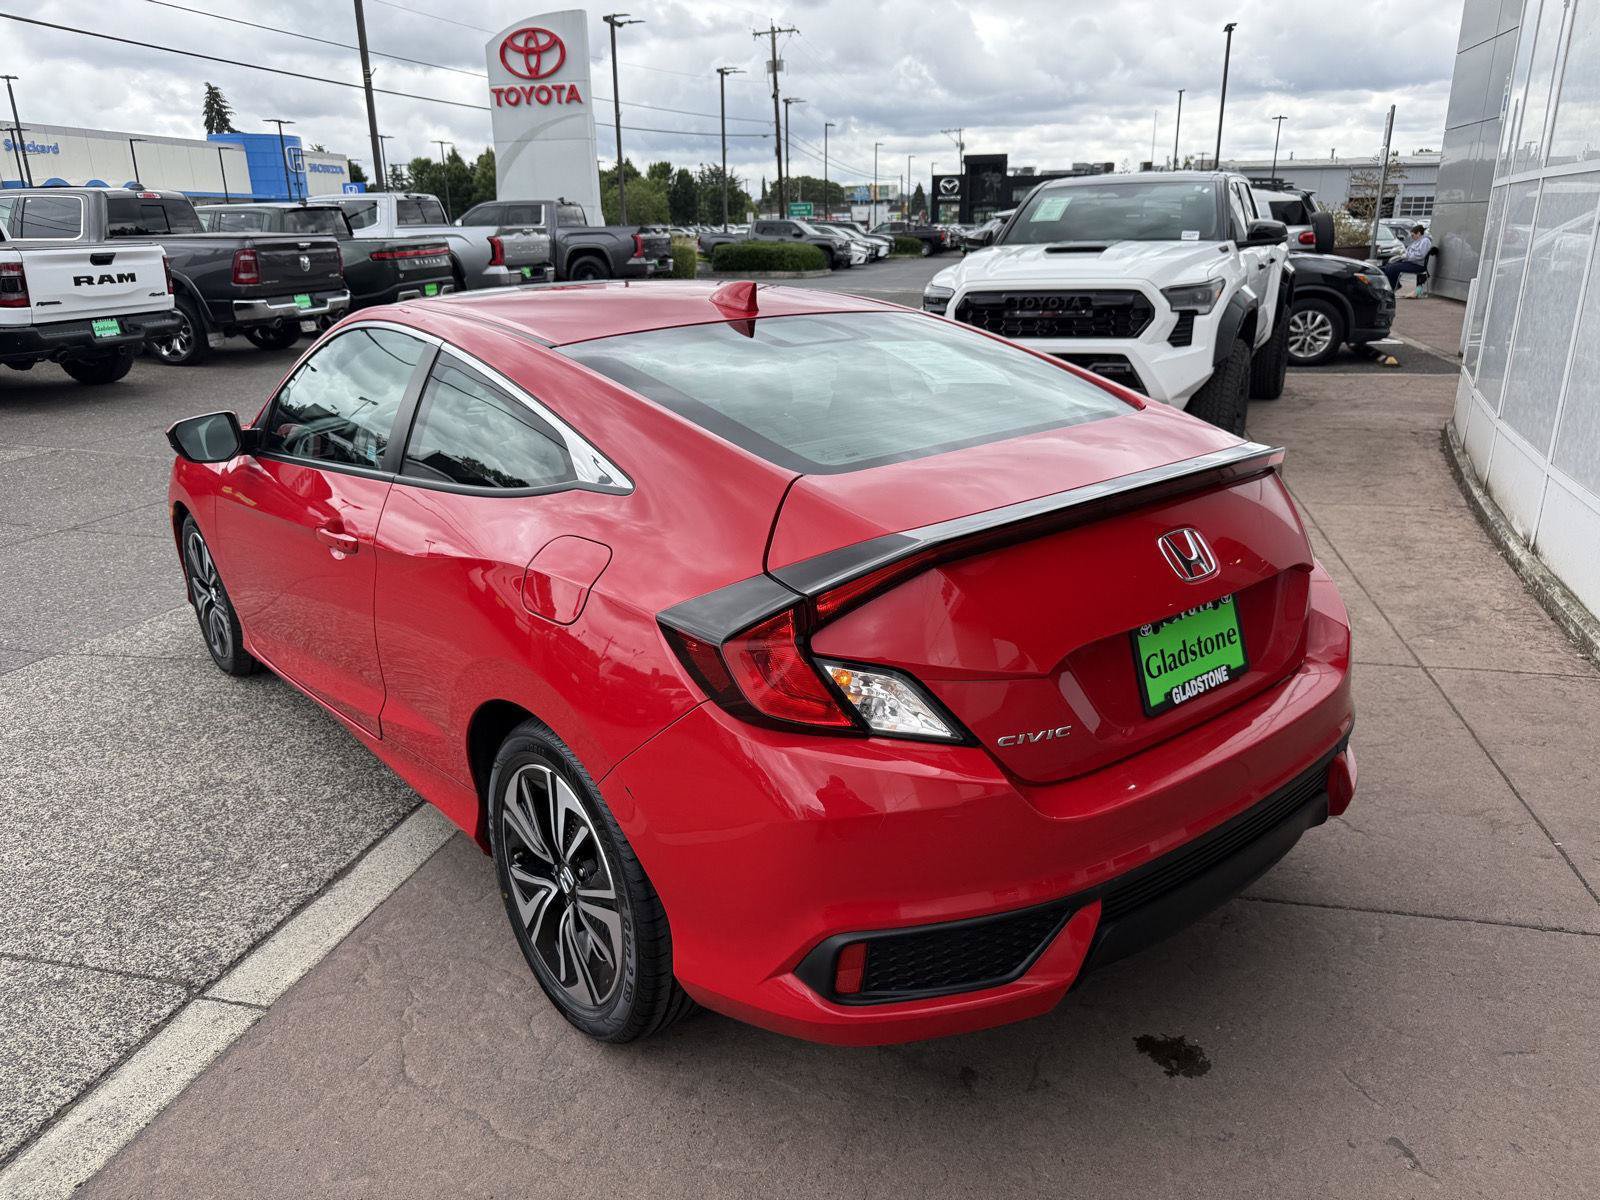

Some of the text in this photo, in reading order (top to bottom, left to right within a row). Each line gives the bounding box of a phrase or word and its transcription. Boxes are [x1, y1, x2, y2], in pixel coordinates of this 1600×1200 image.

[491, 84, 583, 107] TOYOTA
[73, 272, 137, 287] RAM
[1015, 297, 1082, 309] TOYOTA
[1145, 627, 1237, 679] Gladstone
[1172, 665, 1229, 704] GLADSTONE
[997, 725, 1072, 747] CIVIC
